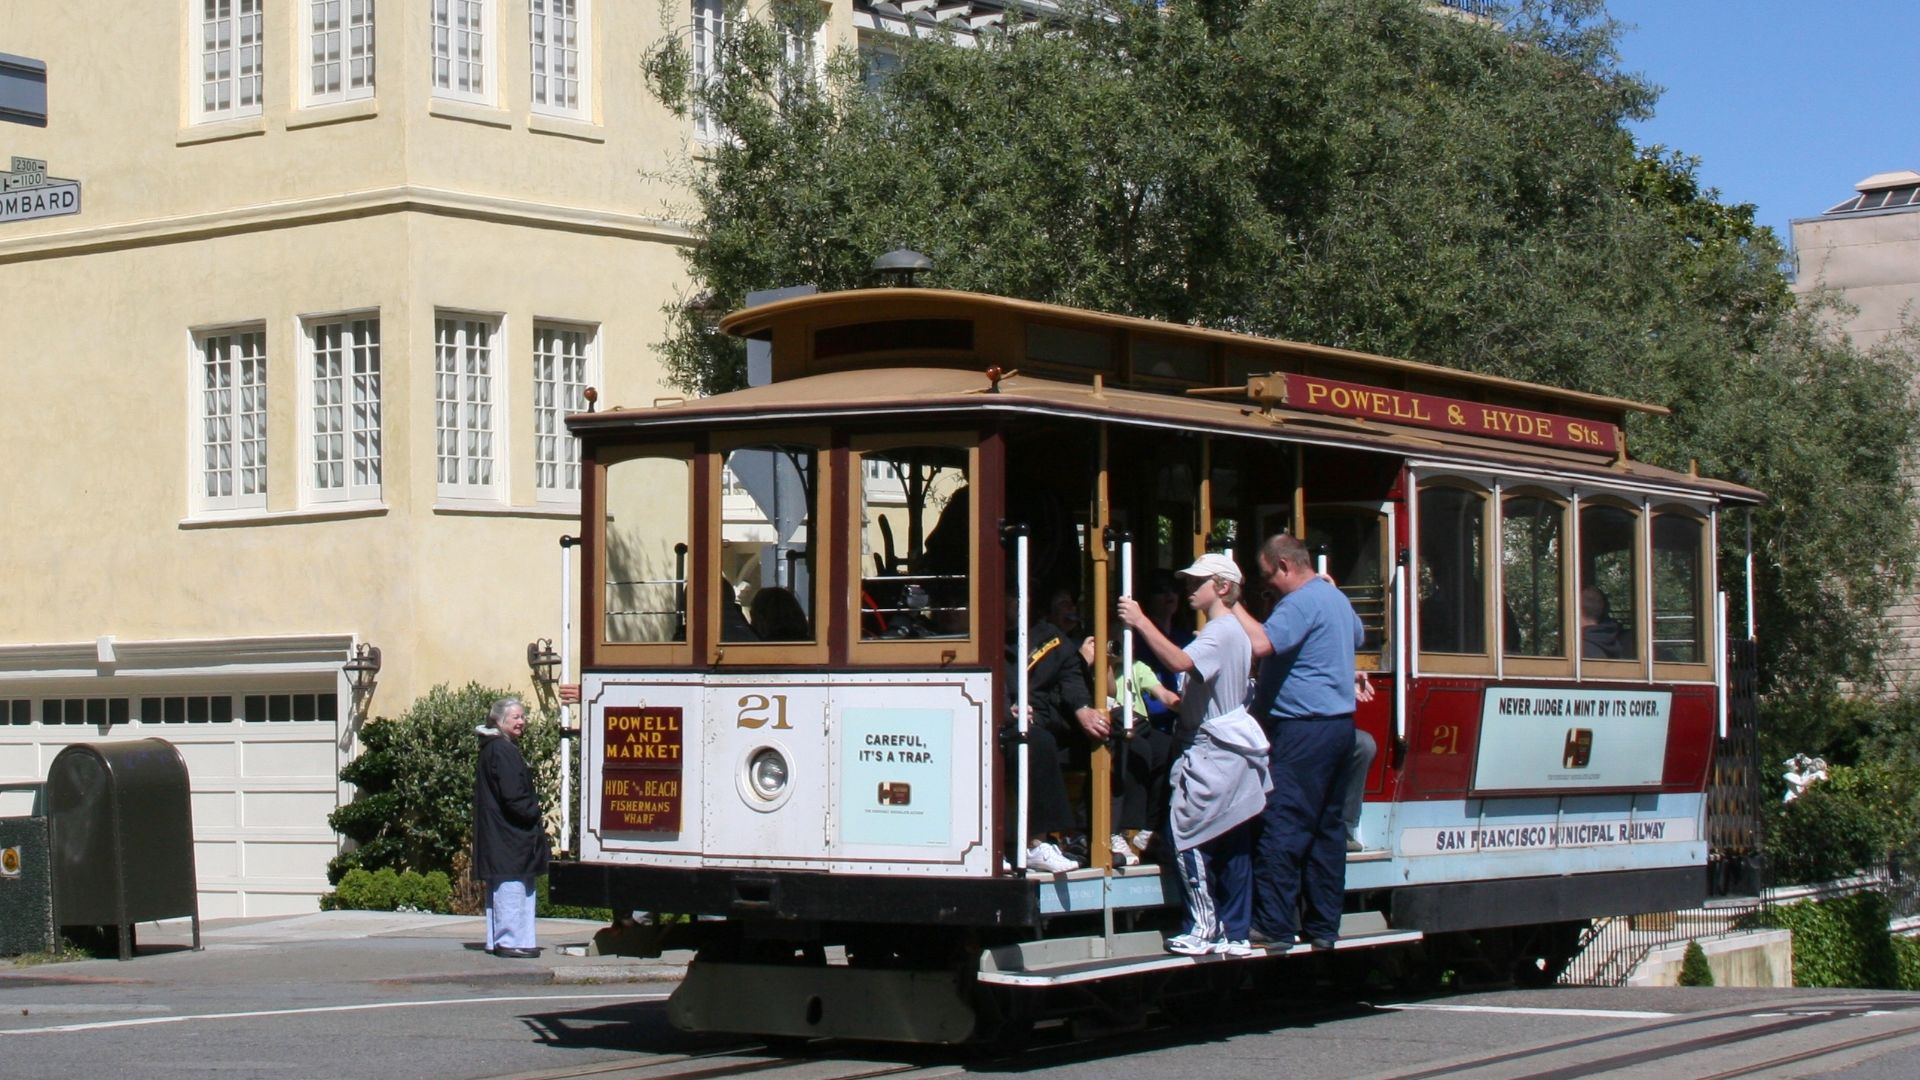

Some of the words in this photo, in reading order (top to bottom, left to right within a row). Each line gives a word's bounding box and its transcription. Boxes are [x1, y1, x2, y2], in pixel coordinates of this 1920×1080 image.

[16, 159, 37, 172] 2300
[21, 173, 42, 186] 1100
[1306, 383, 1431, 421] POWELL
[1447, 404, 1467, 426] &
[1482, 409, 1553, 438] HYDE
[1567, 423, 1604, 446] Sts.
[737, 694, 793, 730] 21
[1499, 697, 1531, 716] NEVER
[1533, 699, 1564, 717] JUDGE
[1565, 700, 1572, 716] A
[1574, 700, 1596, 717] MINT
[1599, 700, 1610, 717] BY
[1612, 700, 1627, 717] ITS
[1629, 700, 1660, 717] COVER.
[607, 716, 679, 731] POWELL
[626, 731, 662, 743] AND
[865, 734, 927, 749] CAREFUL,
[1431, 725, 1458, 754] 21
[606, 743, 680, 758] MARKET
[858, 750, 883, 762] IT'S
[886, 751, 895, 763] A
[898, 751, 934, 764] TRAP.
[604, 780, 629, 796] HYDE
[644, 780, 678, 797] BEACH
[610, 800, 671, 813] FISHERMANS
[623, 813, 656, 825] WHARF
[1436, 831, 1465, 850] SAN
[1470, 826, 1546, 848] FRANCISCO
[1549, 824, 1614, 845] MUNICIPAL
[1619, 821, 1665, 841] RAILWAY
